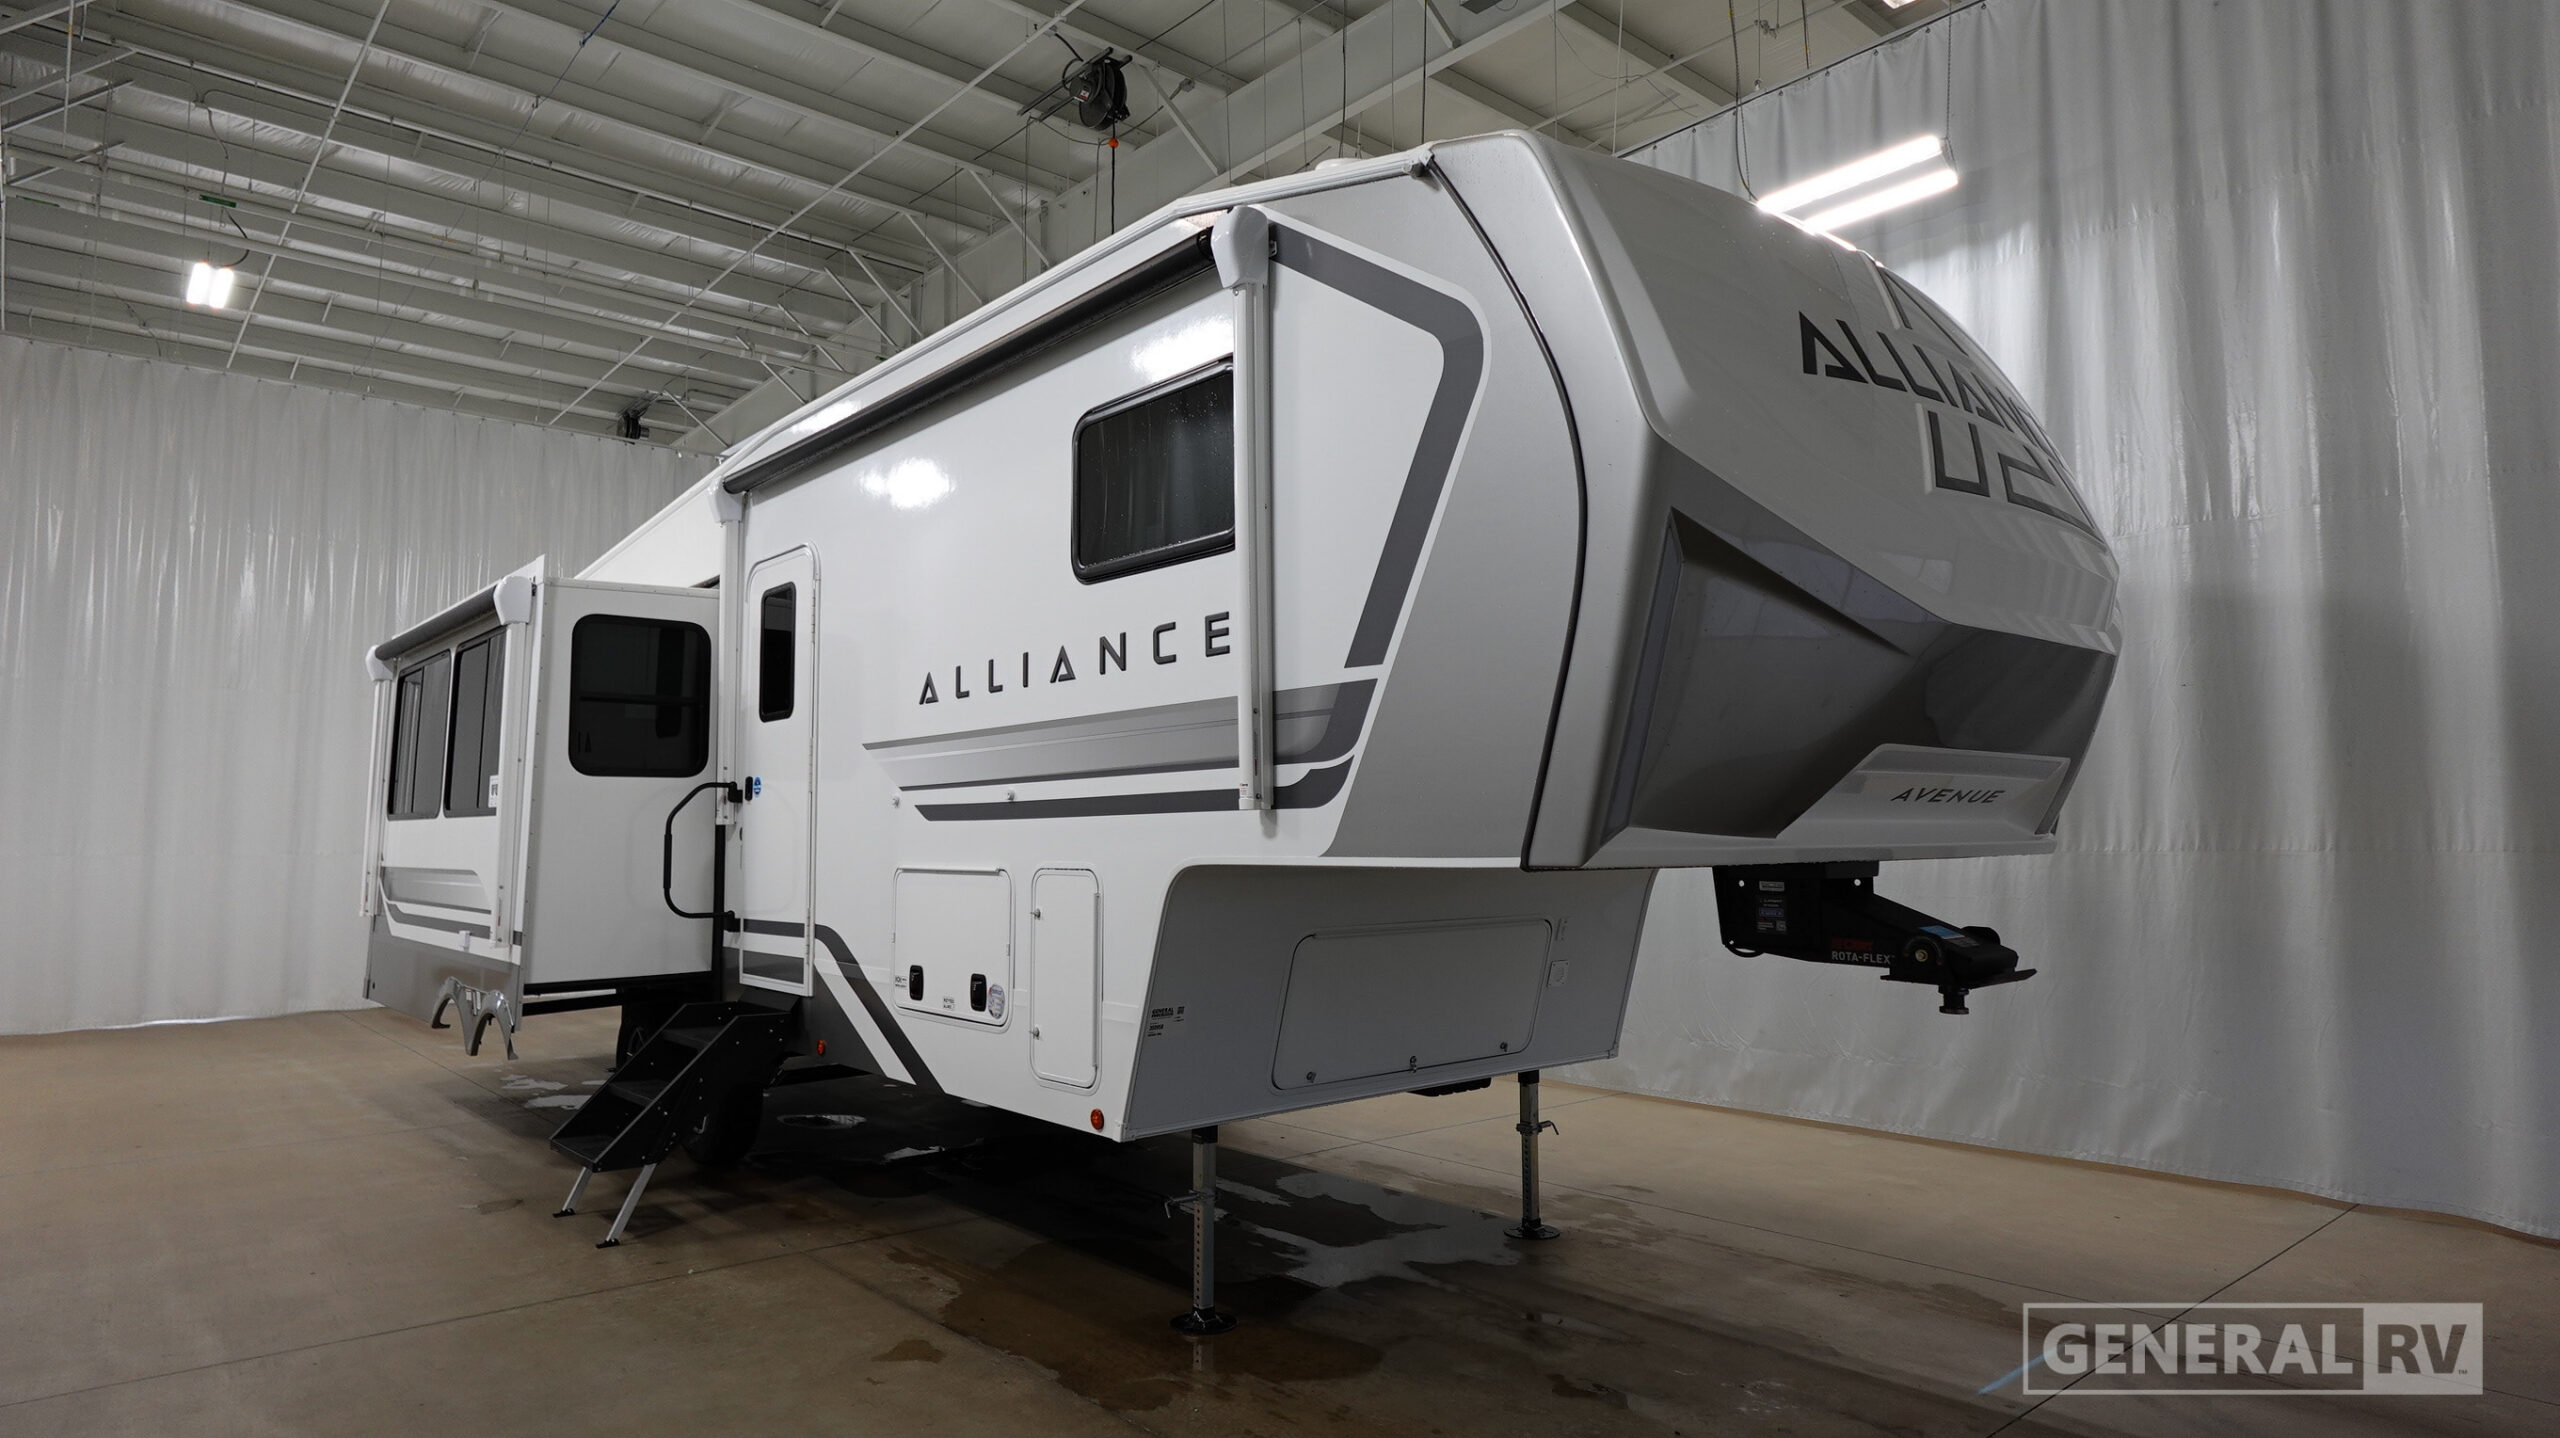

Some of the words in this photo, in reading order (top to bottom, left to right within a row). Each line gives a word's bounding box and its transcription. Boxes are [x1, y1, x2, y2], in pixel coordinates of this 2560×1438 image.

[1799, 310, 2060, 466] ALLIAN
[918, 611, 1231, 706] ALLIANCE
[1890, 787, 2005, 804] AVENUE
